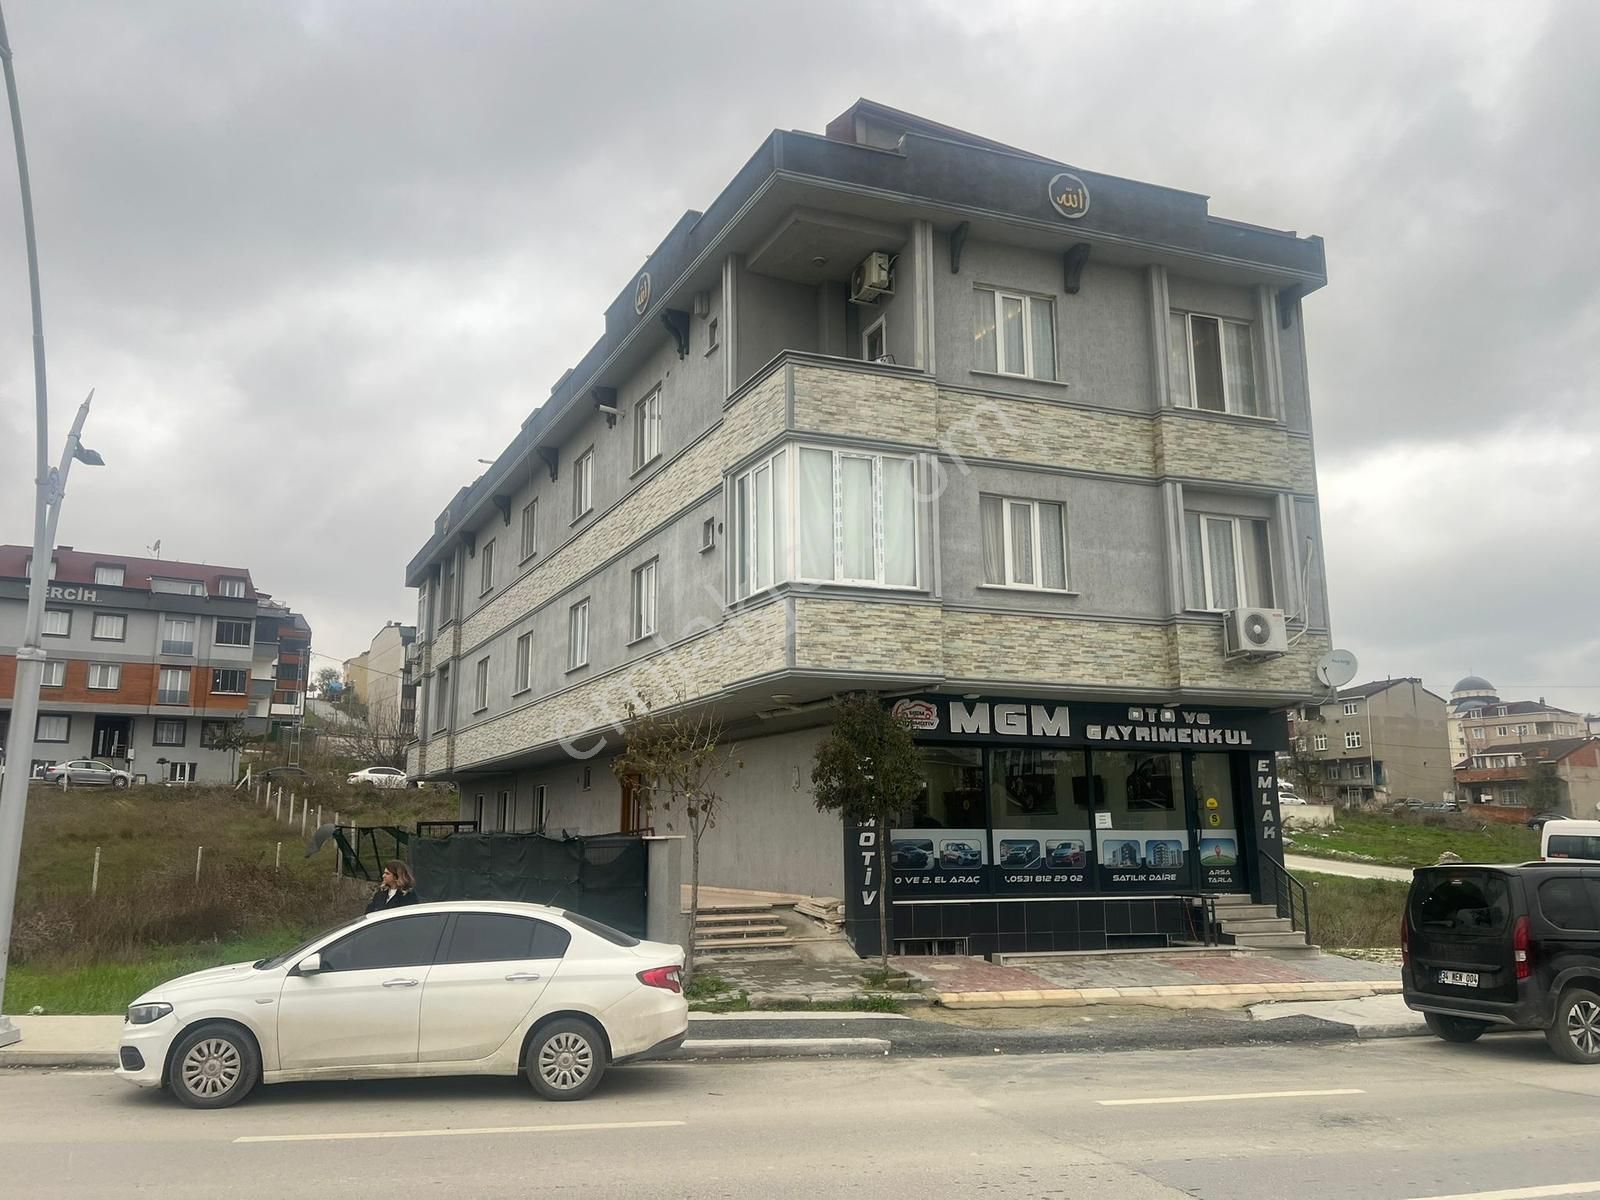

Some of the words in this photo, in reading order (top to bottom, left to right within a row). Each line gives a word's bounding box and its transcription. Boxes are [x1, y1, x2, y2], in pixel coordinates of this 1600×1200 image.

[949, 701, 1071, 737] MGM
[1128, 706, 1176, 723] OTO
[1257, 759, 1276, 839] EMLAK
[905, 876, 920, 884] VE
[934, 876, 947, 884] EL
[949, 876, 980, 885] ARAÇ
[1009, 875, 1033, 883] 0531
[1035, 875, 1052, 883] 812
[1054, 875, 1068, 883] 29
[1069, 875, 1084, 883] 02
[1112, 874, 1147, 882] SATILIK
